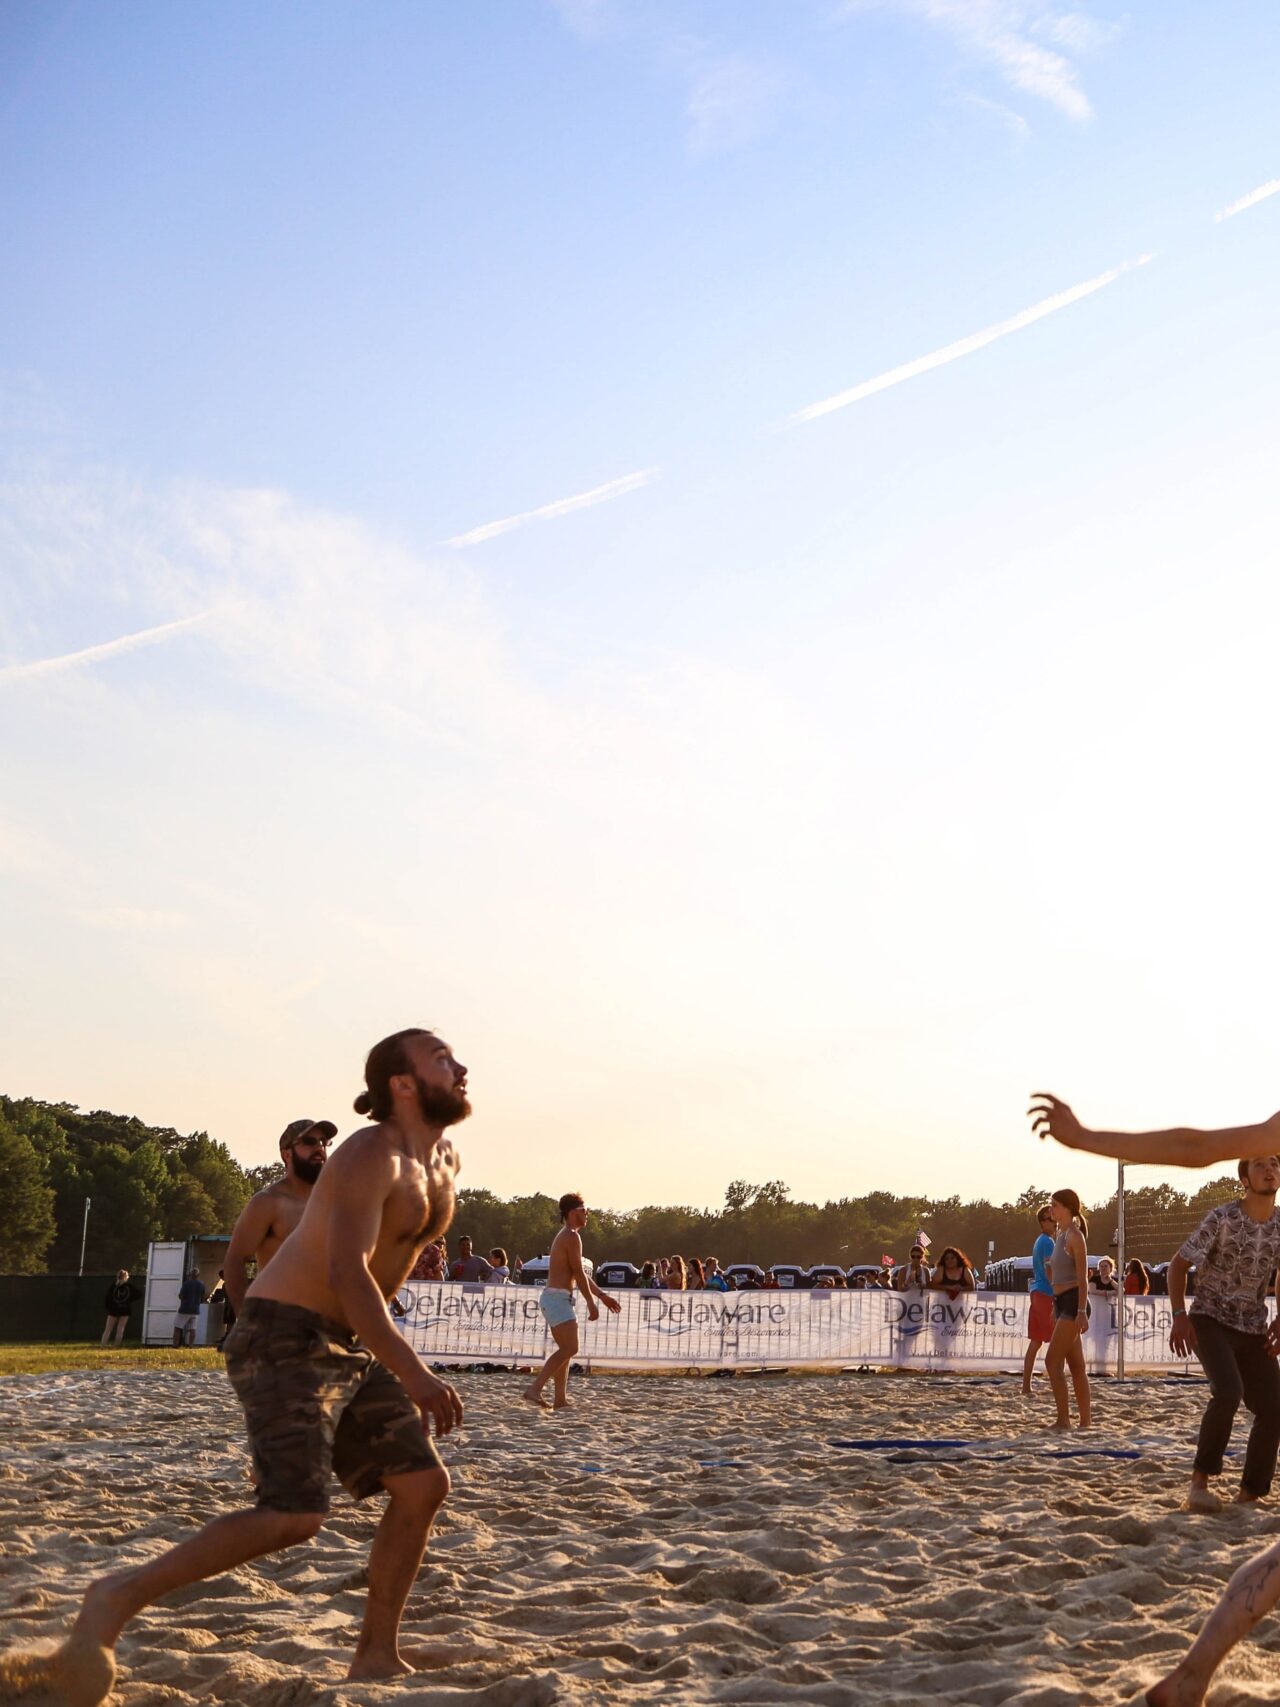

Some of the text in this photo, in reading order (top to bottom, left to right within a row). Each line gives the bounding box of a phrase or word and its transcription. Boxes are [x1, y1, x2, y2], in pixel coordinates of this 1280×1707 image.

[640, 1295, 786, 1324] Delaware
[884, 1295, 1018, 1326] Delaware
[1108, 1303, 1172, 1329] Dela
